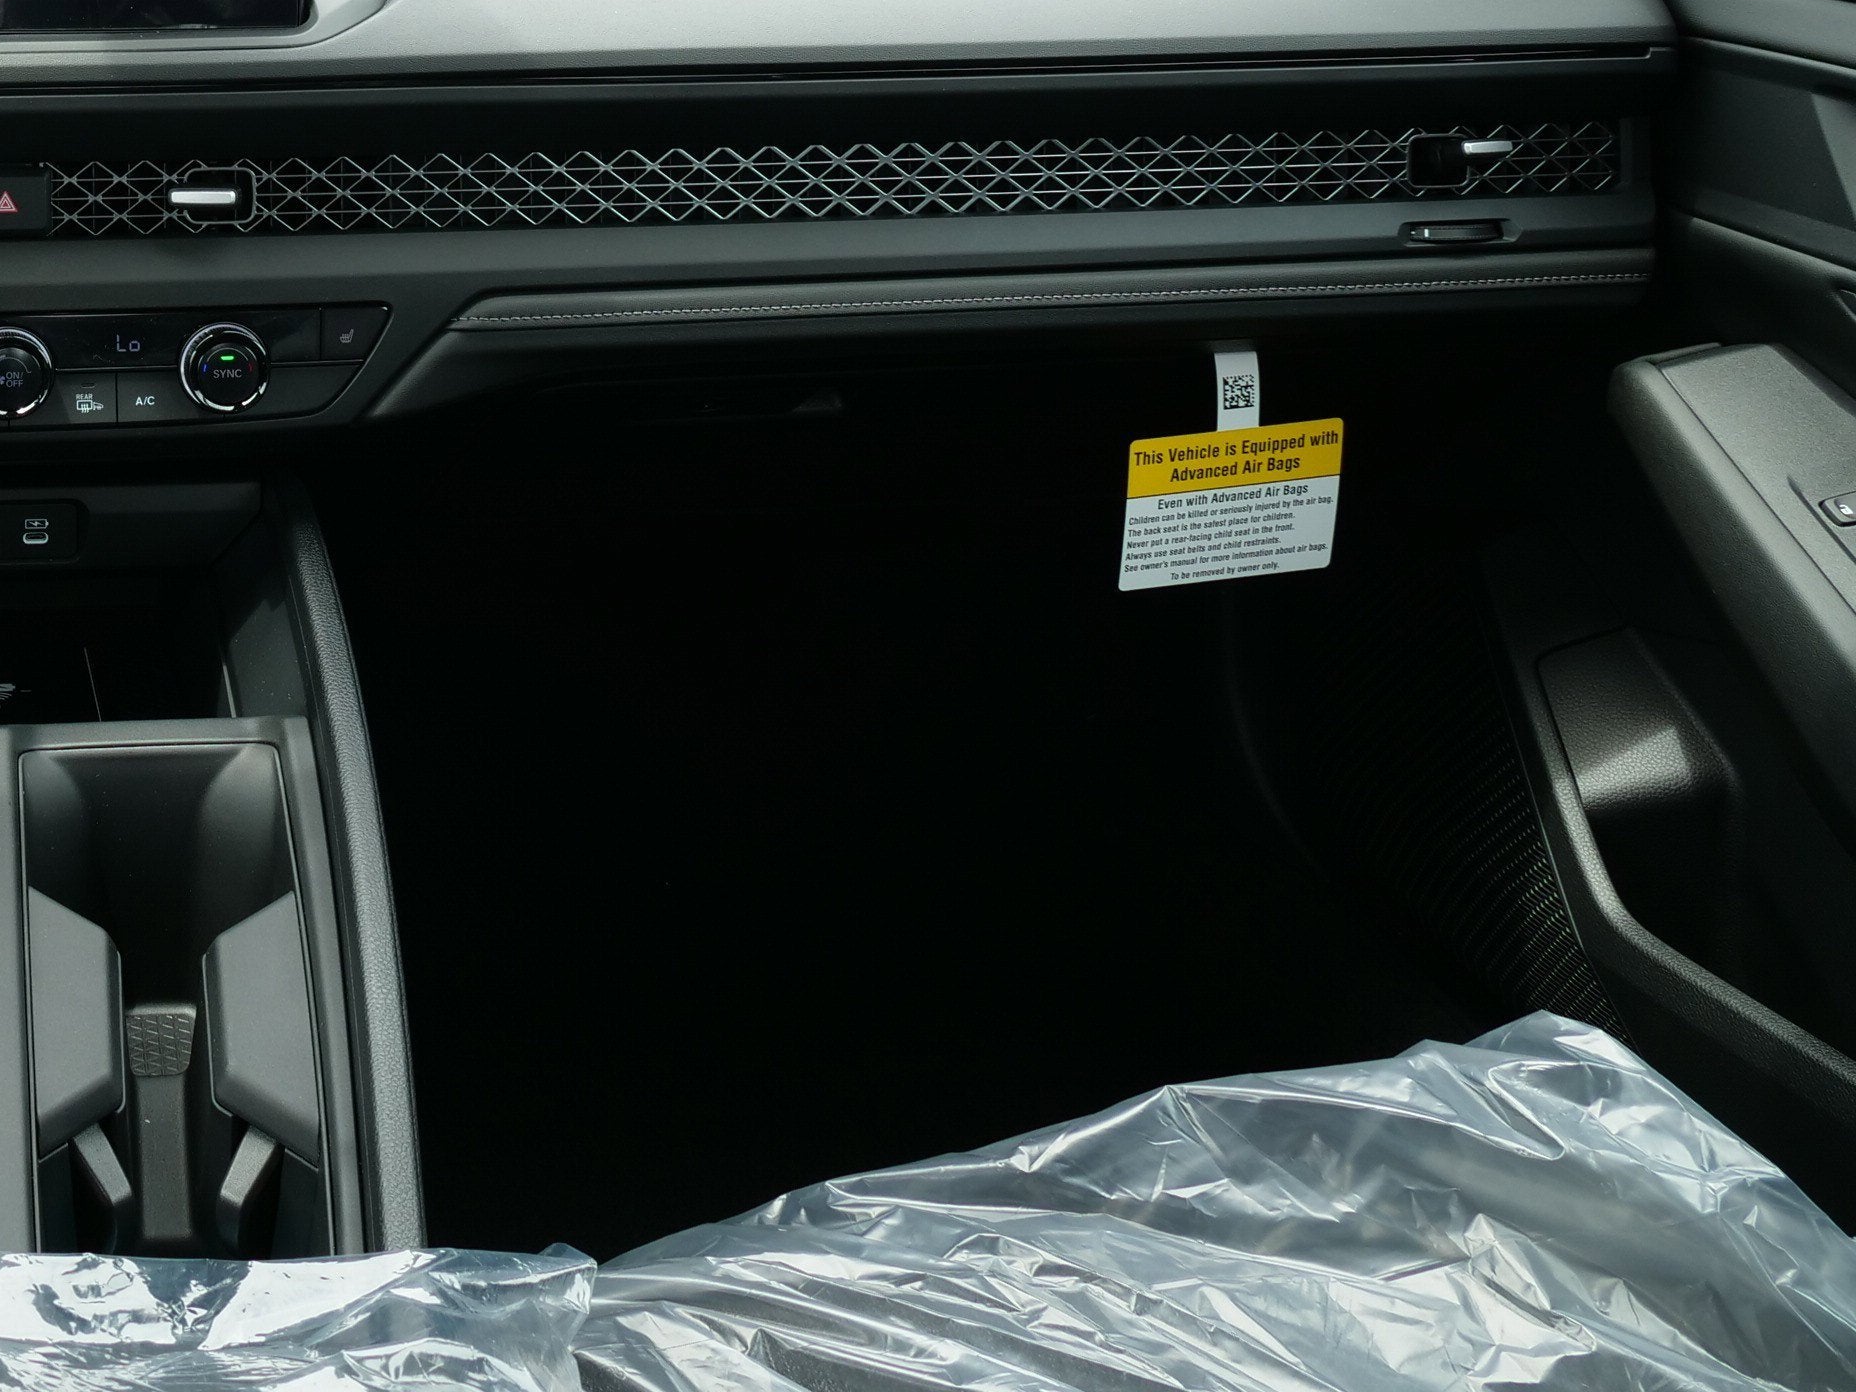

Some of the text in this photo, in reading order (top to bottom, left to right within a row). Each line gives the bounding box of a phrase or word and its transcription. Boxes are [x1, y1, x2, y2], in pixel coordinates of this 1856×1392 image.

[213, 369, 242, 379] SYNC
[5, 379, 23, 388] OFF
[135, 395, 155, 406] A/C
[1134, 431, 1339, 466] This Vehicle is Equipped with
[1170, 456, 1300, 482] Advanced Air Bags
[1158, 484, 1309, 510] Even with Advanced Air Bags
